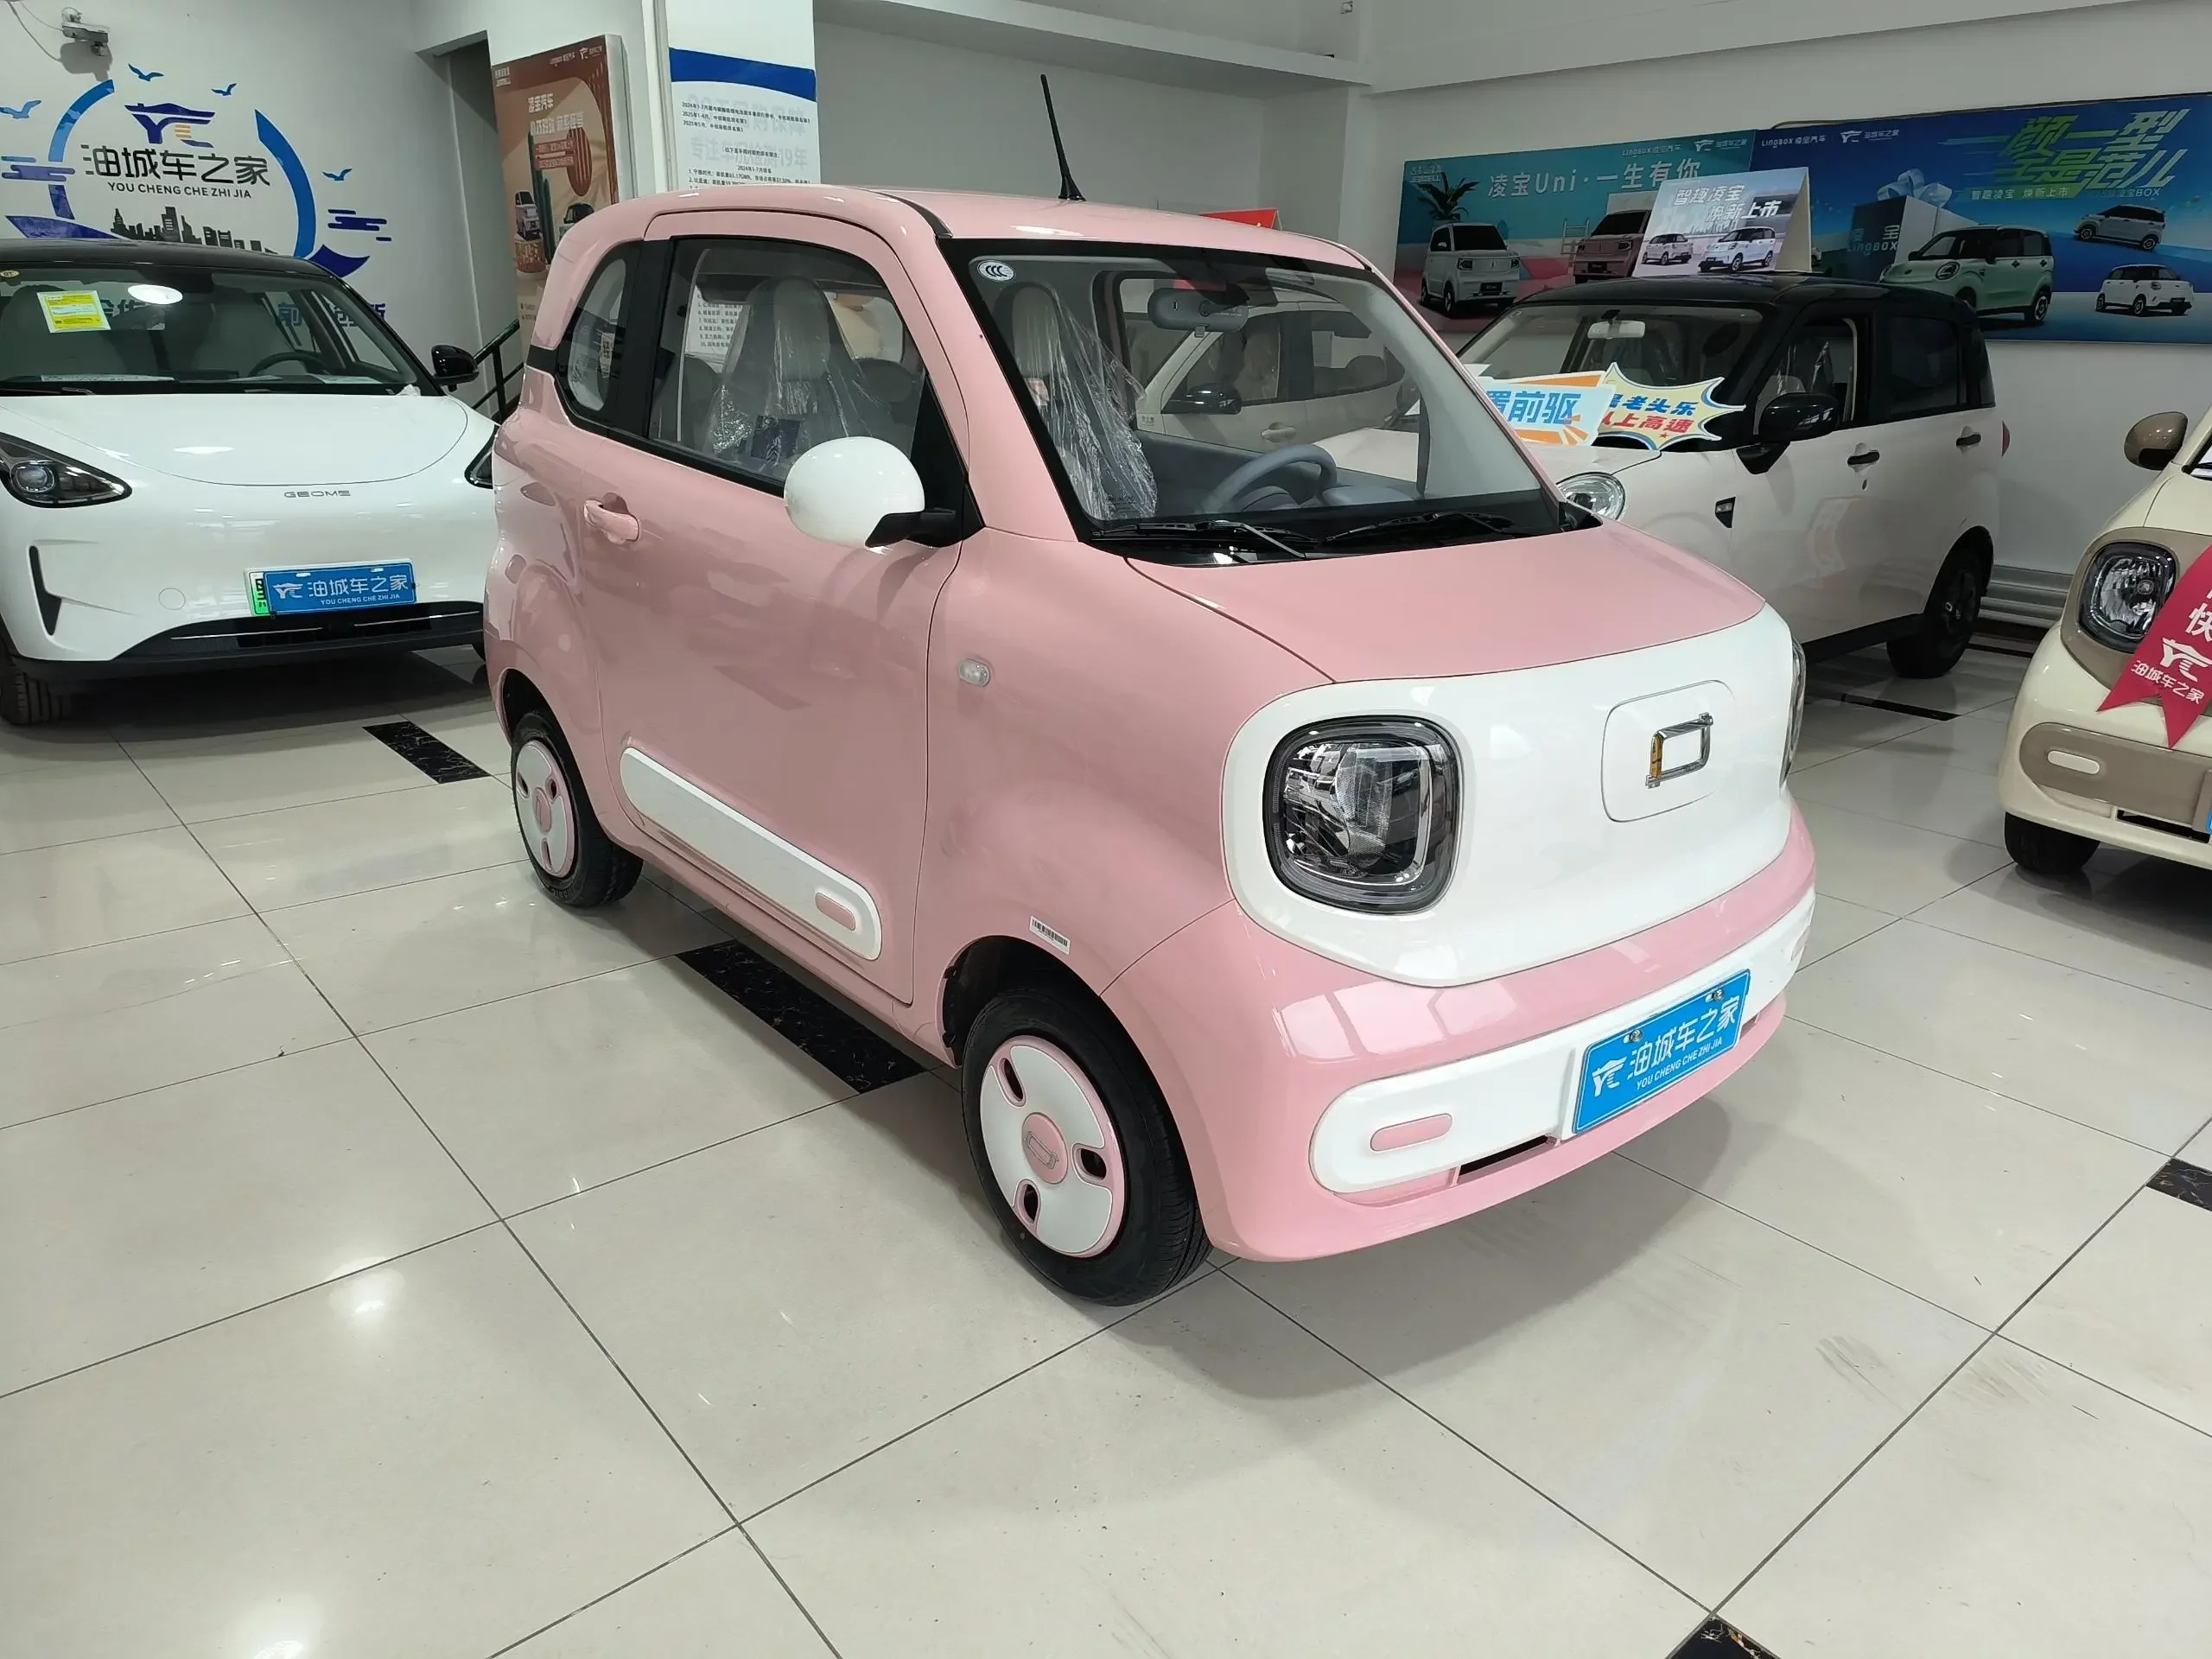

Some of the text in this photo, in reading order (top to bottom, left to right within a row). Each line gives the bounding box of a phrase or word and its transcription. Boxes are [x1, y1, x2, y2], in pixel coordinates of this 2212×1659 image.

[81, 143, 270, 187] 油城车之家
[107, 181, 252, 199] YOU CHENG CHE ZHI JIA
[283, 490, 352, 499] GEOME
[308, 574, 409, 597] 油城车之家
[337, 596, 362, 605] CHENG
[2130, 659, 2205, 705] 油城车之家
[1627, 995, 1740, 1080] 油城车之家
[1637, 1037, 1722, 1090] YOU CHENG CHE ZHI JIA
